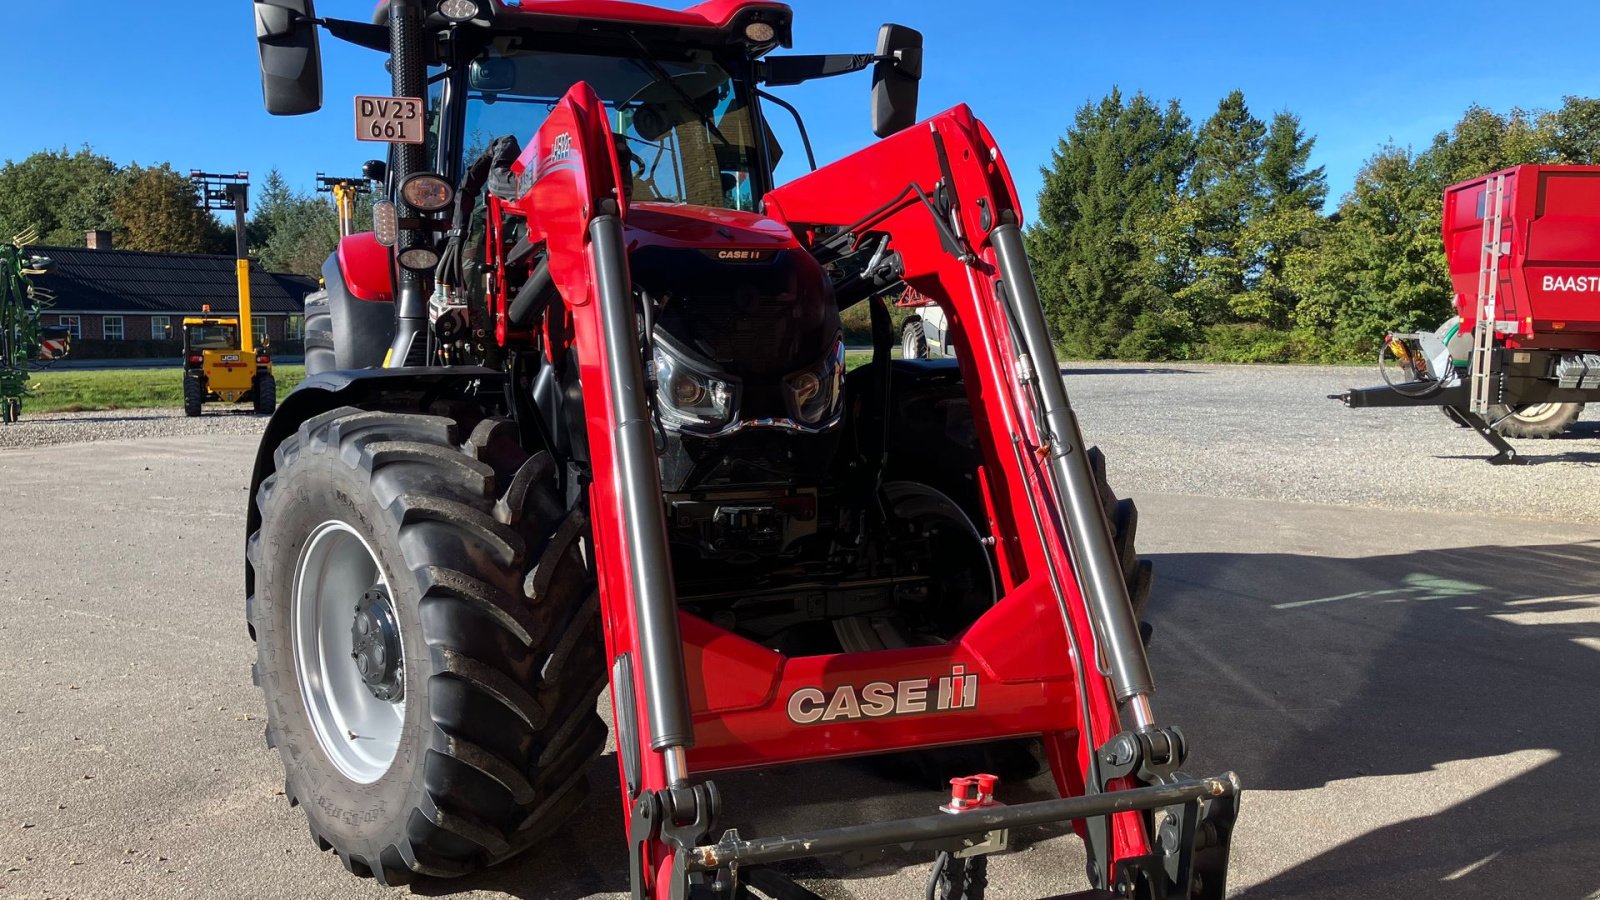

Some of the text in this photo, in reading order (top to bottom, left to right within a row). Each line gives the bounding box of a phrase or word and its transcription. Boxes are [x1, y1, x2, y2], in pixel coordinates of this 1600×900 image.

[361, 99, 416, 119] DV23
[370, 119, 406, 139] 661
[718, 250, 749, 259] CASE
[1542, 275, 1600, 292] BAAST
[787, 678, 929, 724] CASE
